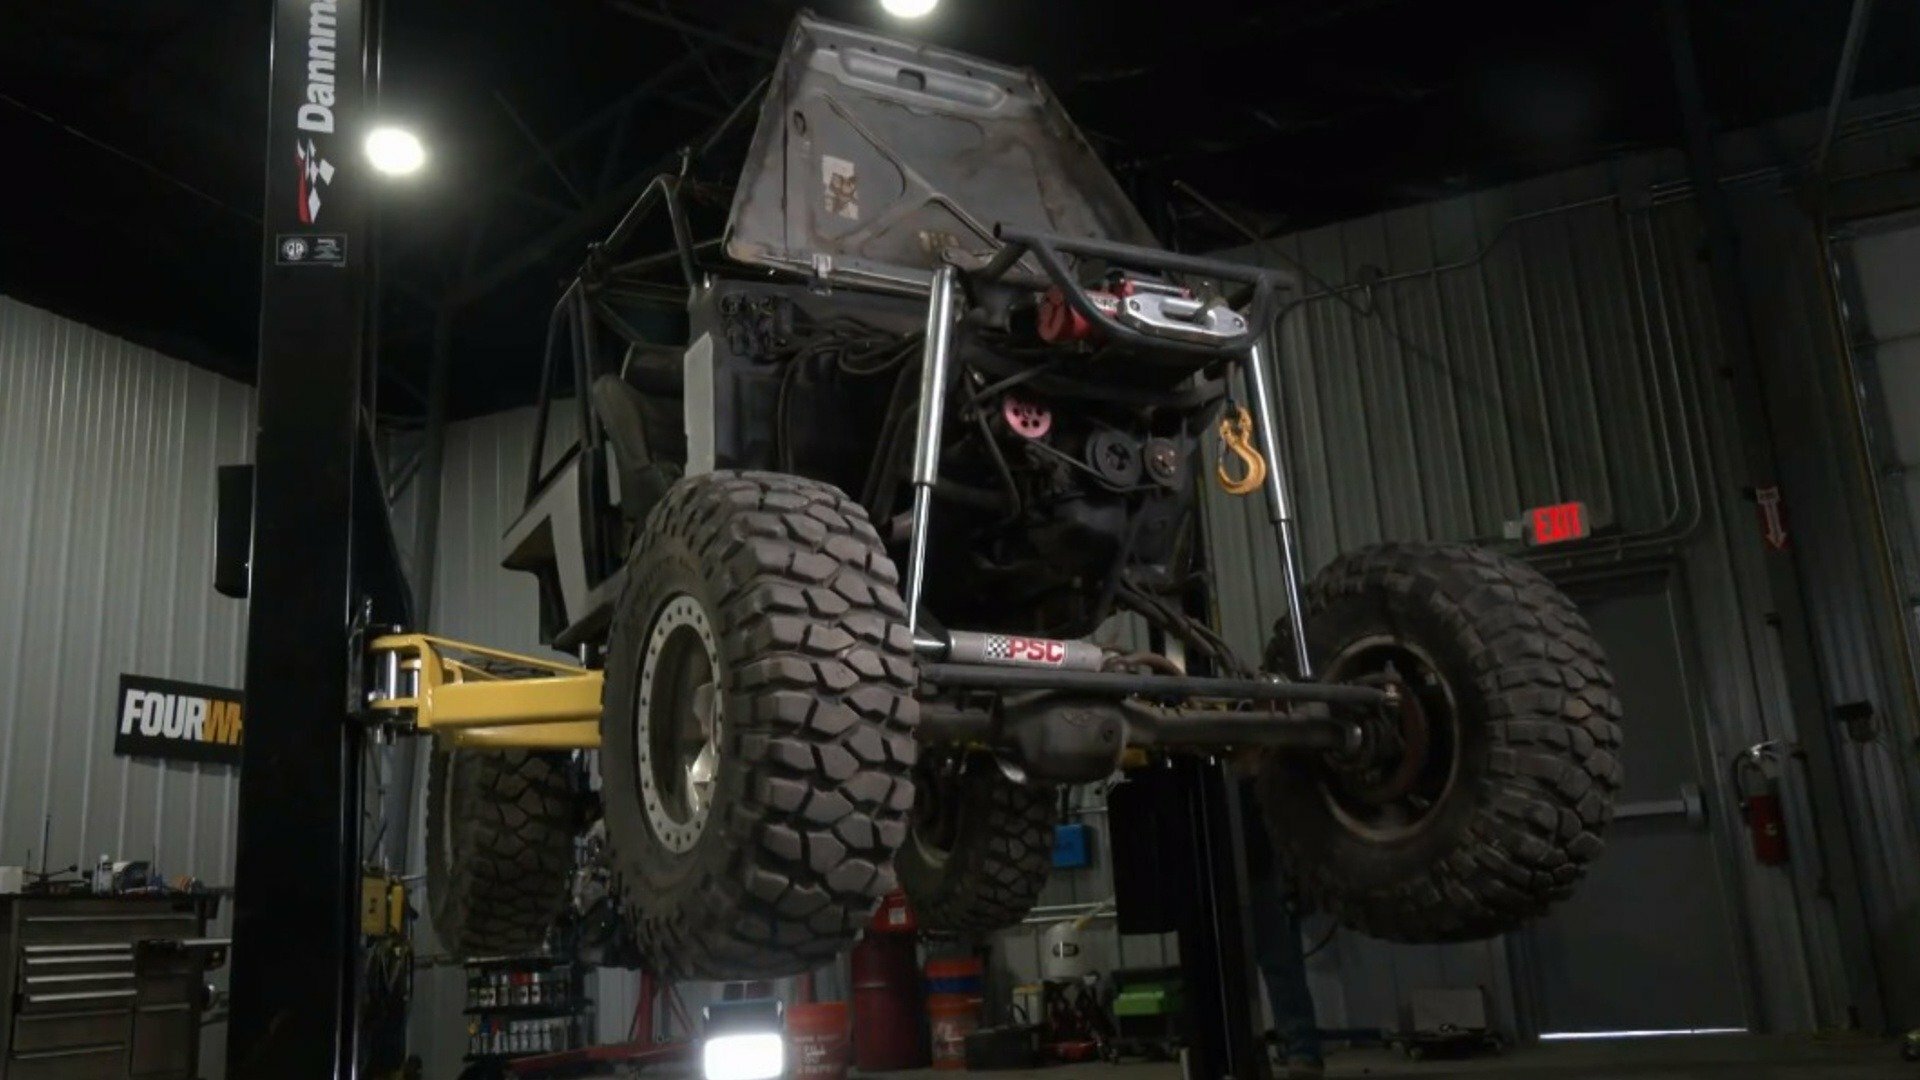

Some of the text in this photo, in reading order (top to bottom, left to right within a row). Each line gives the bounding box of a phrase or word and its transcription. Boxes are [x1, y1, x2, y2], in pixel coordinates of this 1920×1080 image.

[298, 0, 336, 133] Dannm
[1533, 502, 1582, 543] EXIT
[1008, 638, 1063, 662] PSC
